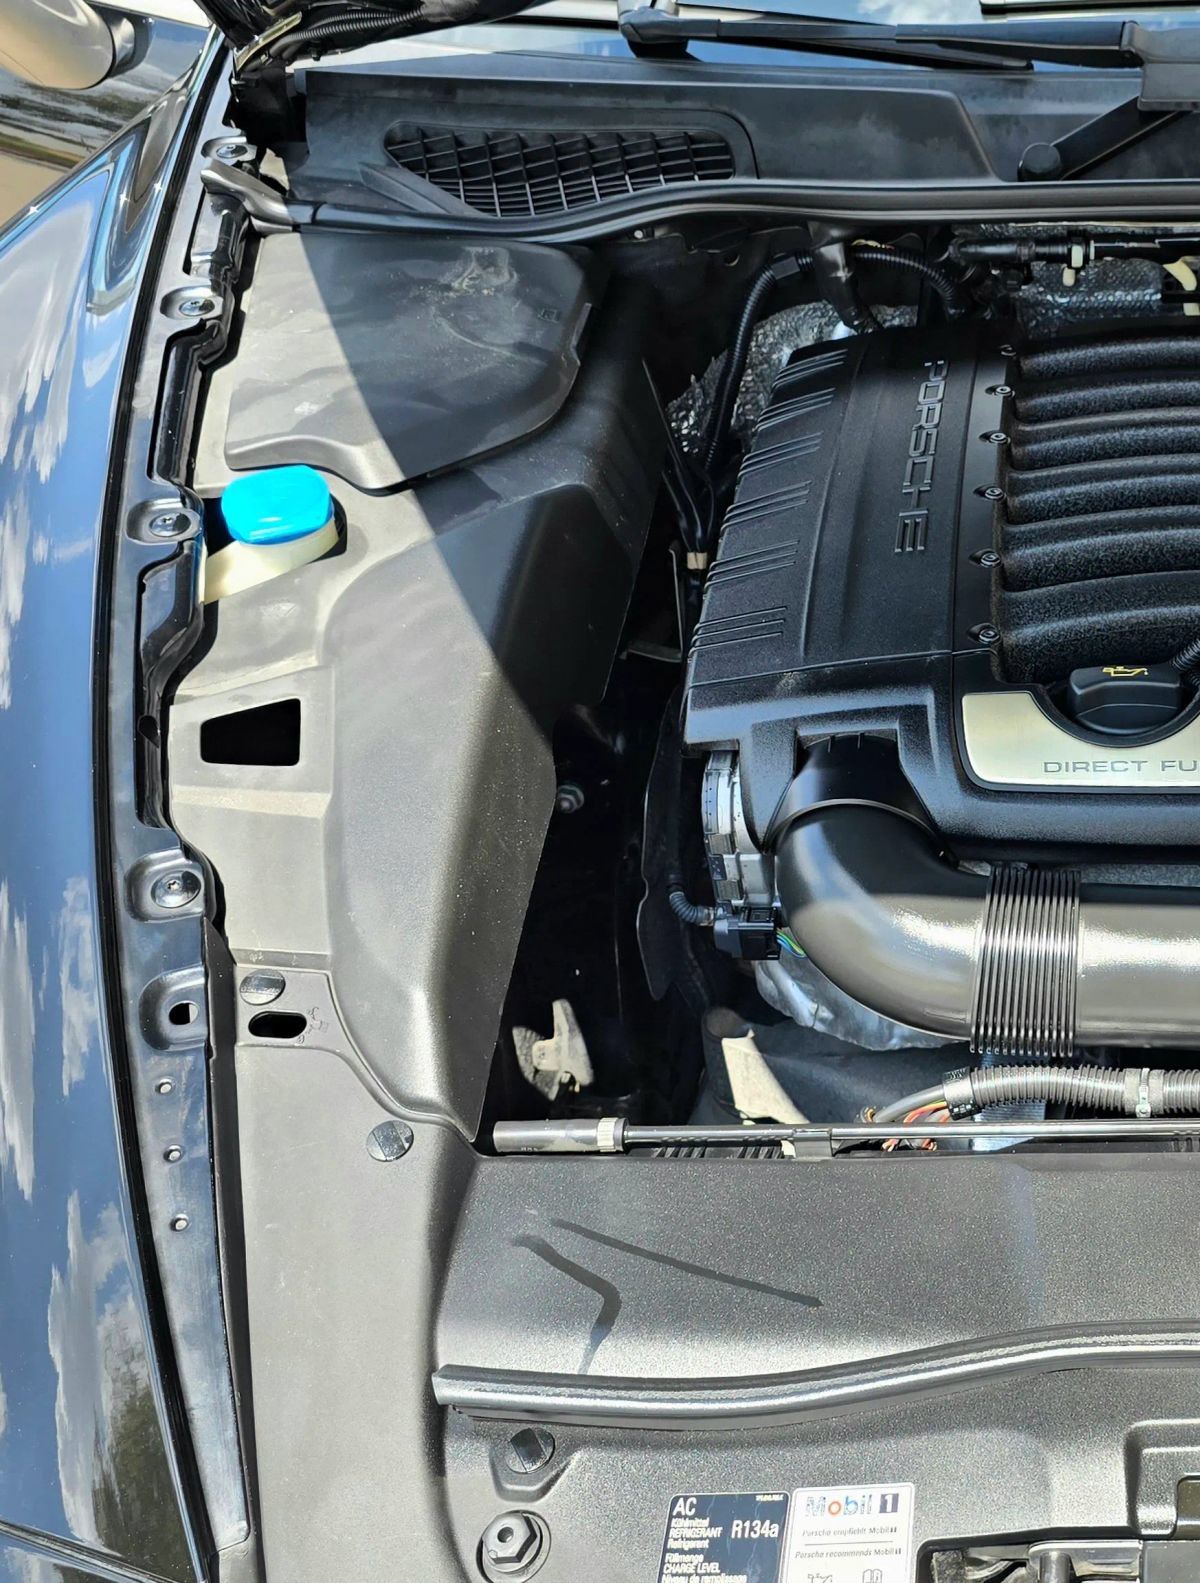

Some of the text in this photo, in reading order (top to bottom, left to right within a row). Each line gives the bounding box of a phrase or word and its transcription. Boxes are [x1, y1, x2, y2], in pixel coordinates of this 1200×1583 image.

[895, 359, 949, 553] PORSCHE
[1043, 759, 1149, 774] DIRECT
[672, 1496, 697, 1516] AC
[805, 1494, 873, 1517] Mobil
[669, 1527, 723, 1539] REFRIGERANT
[731, 1519, 780, 1539] R134a
[802, 1528, 831, 1537] Porsche
[795, 1549, 824, 1559] Porsche
[825, 1547, 872, 1558] recommends
[663, 1562, 721, 1574] CHARGE LEVEL
